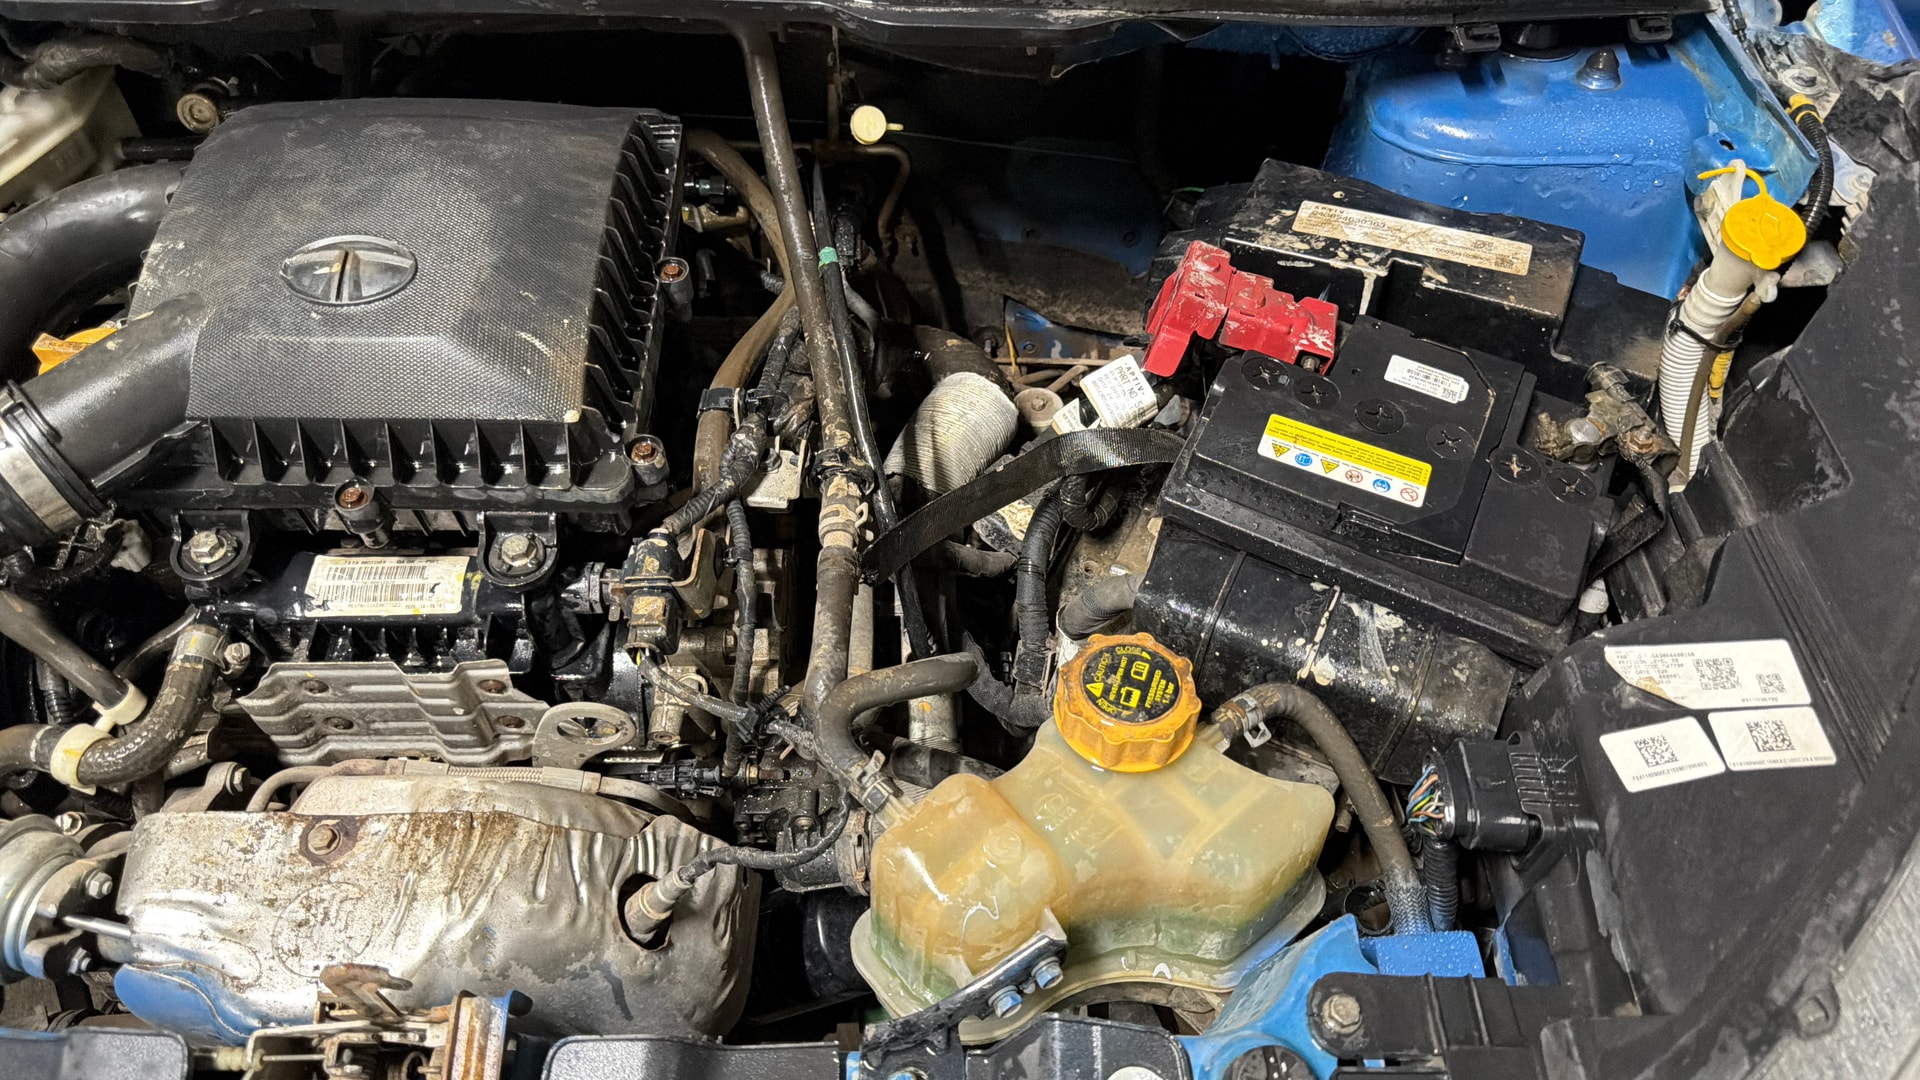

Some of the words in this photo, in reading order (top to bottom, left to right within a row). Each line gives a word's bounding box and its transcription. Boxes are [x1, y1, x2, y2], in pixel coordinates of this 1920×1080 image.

[1114, 366, 1130, 385] PART
[1128, 388, 1138, 398] NO
[1115, 646, 1142, 654] CLOSE
[1094, 652, 1111, 682] CAUTION
[1165, 682, 1174, 694] bar
